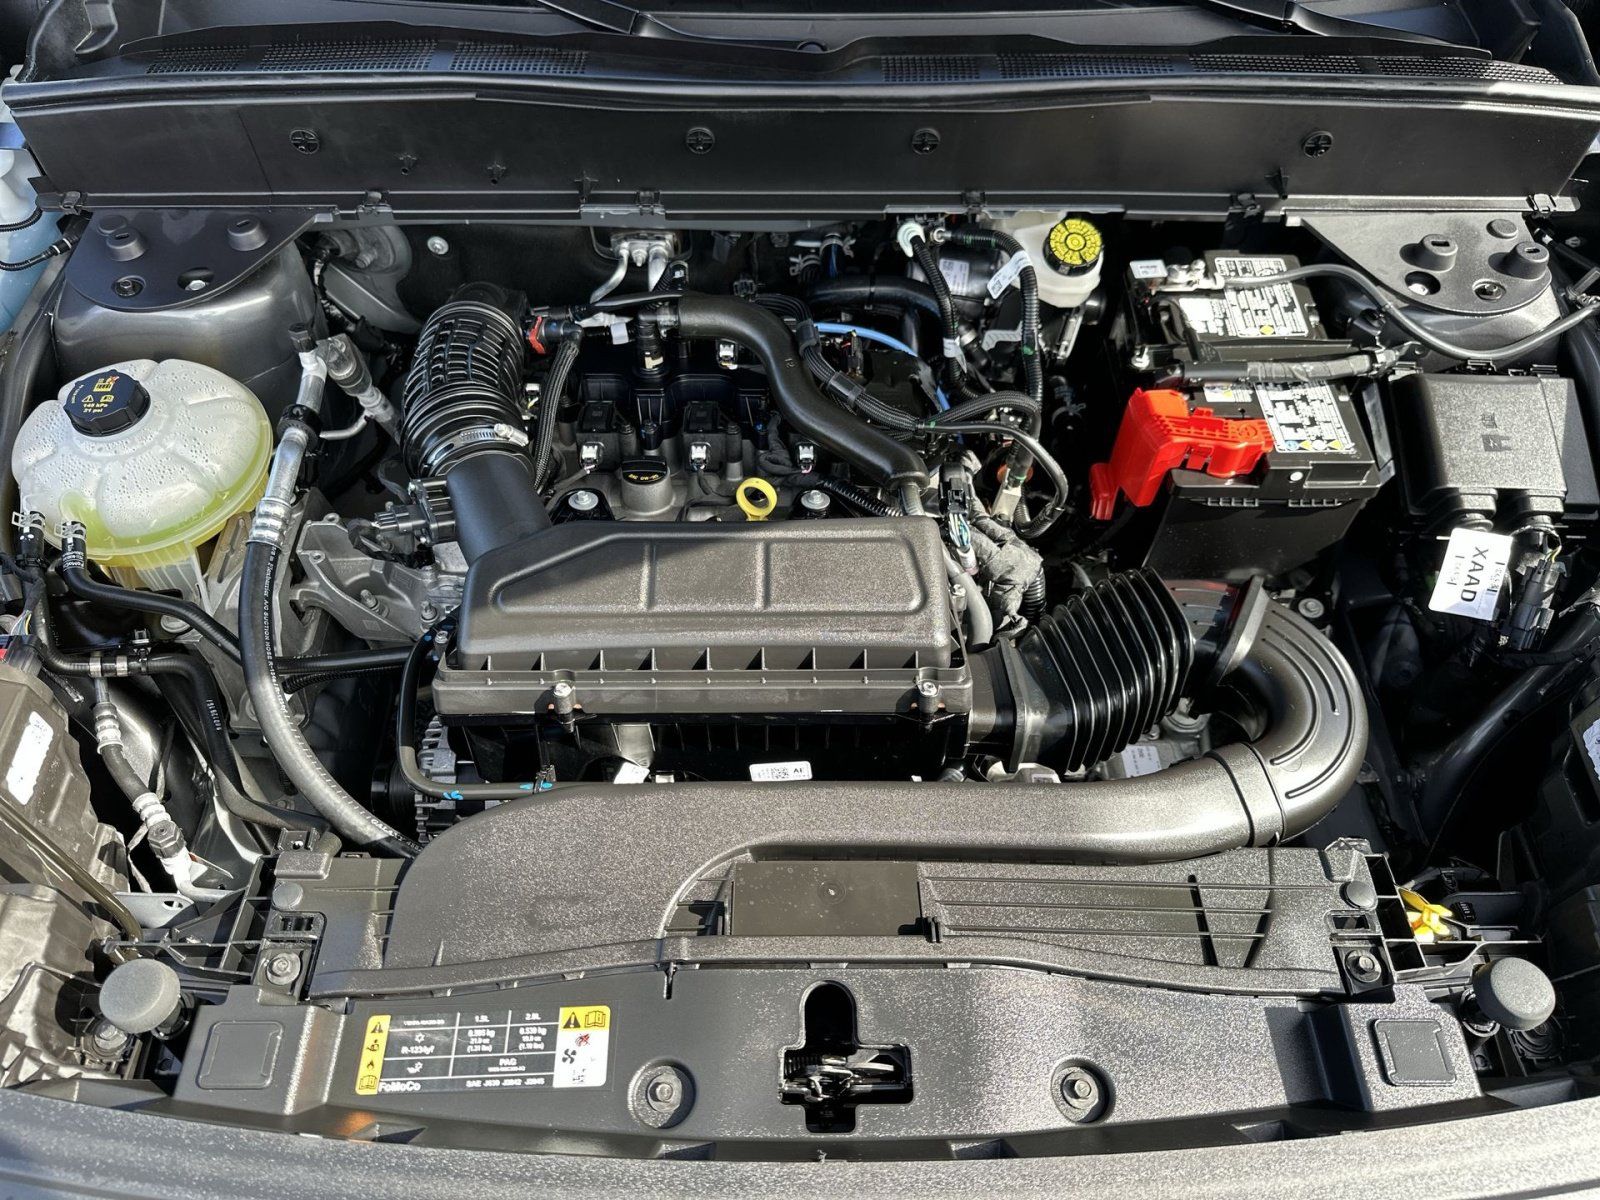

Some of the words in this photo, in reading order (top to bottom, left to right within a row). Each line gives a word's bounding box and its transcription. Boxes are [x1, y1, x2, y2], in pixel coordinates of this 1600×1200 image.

[1460, 546, 1489, 602] XAAD
[264, 641, 273, 660] HOSE
[268, 660, 278, 683] R-134a
[474, 1014, 490, 1022] 1.5L
[525, 1012, 542, 1020] 2.0L
[486, 1028, 496, 1038] kg
[537, 1026, 548, 1036] kg
[378, 1081, 421, 1092] FoMoCo
